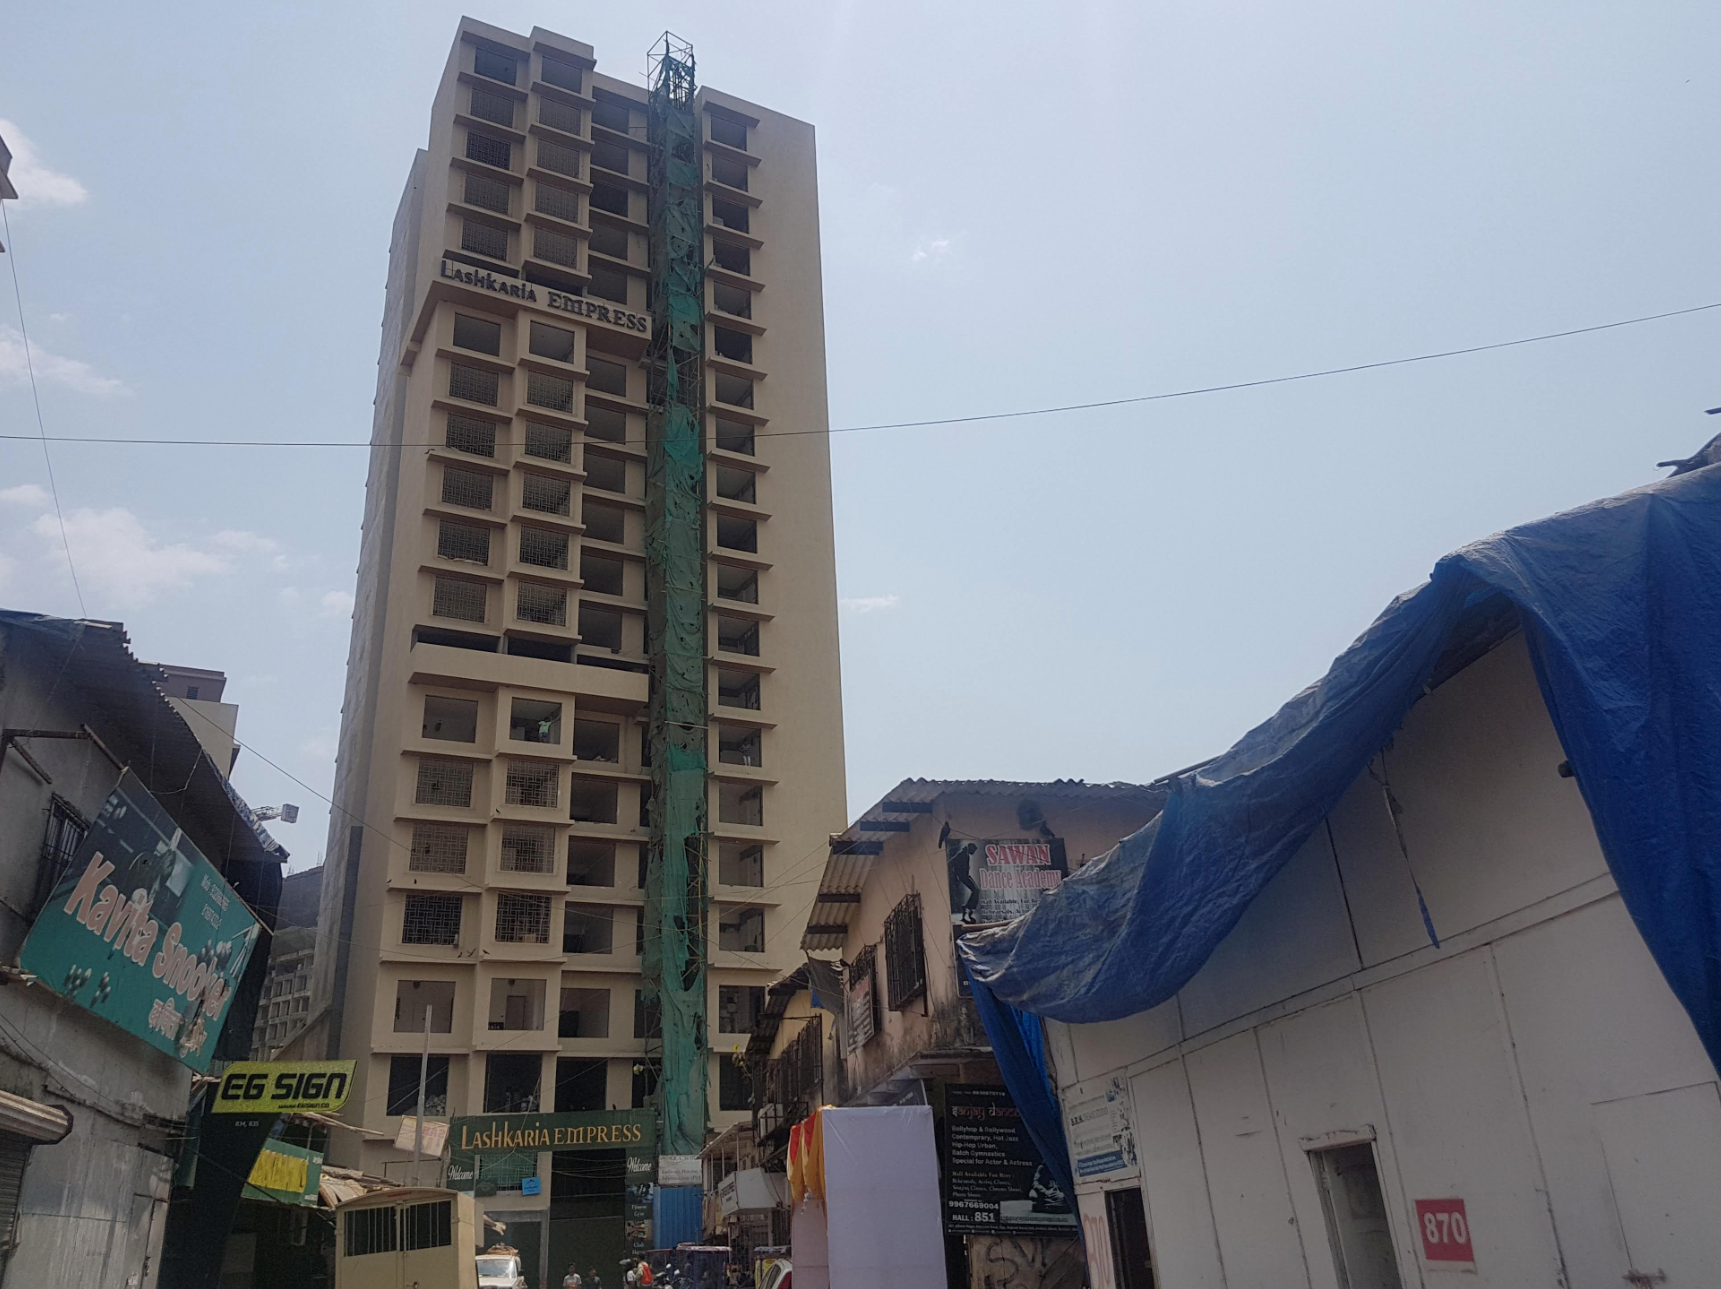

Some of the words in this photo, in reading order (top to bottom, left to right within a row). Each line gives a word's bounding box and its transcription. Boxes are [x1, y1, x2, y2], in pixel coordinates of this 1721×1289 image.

[547, 290, 647, 333] EMPRESS
[985, 844, 1052, 866] SAWAN
[979, 868, 1014, 890] Dance
[63, 851, 159, 967] Kavita
[221, 1073, 269, 1100] EG
[553, 1123, 641, 1145] EMPRESS
[447, 1165, 474, 1180] Welcome
[627, 1156, 652, 1173] Welcome
[974, 1211, 996, 1223] 851
[1423, 1211, 1467, 1244] 870
